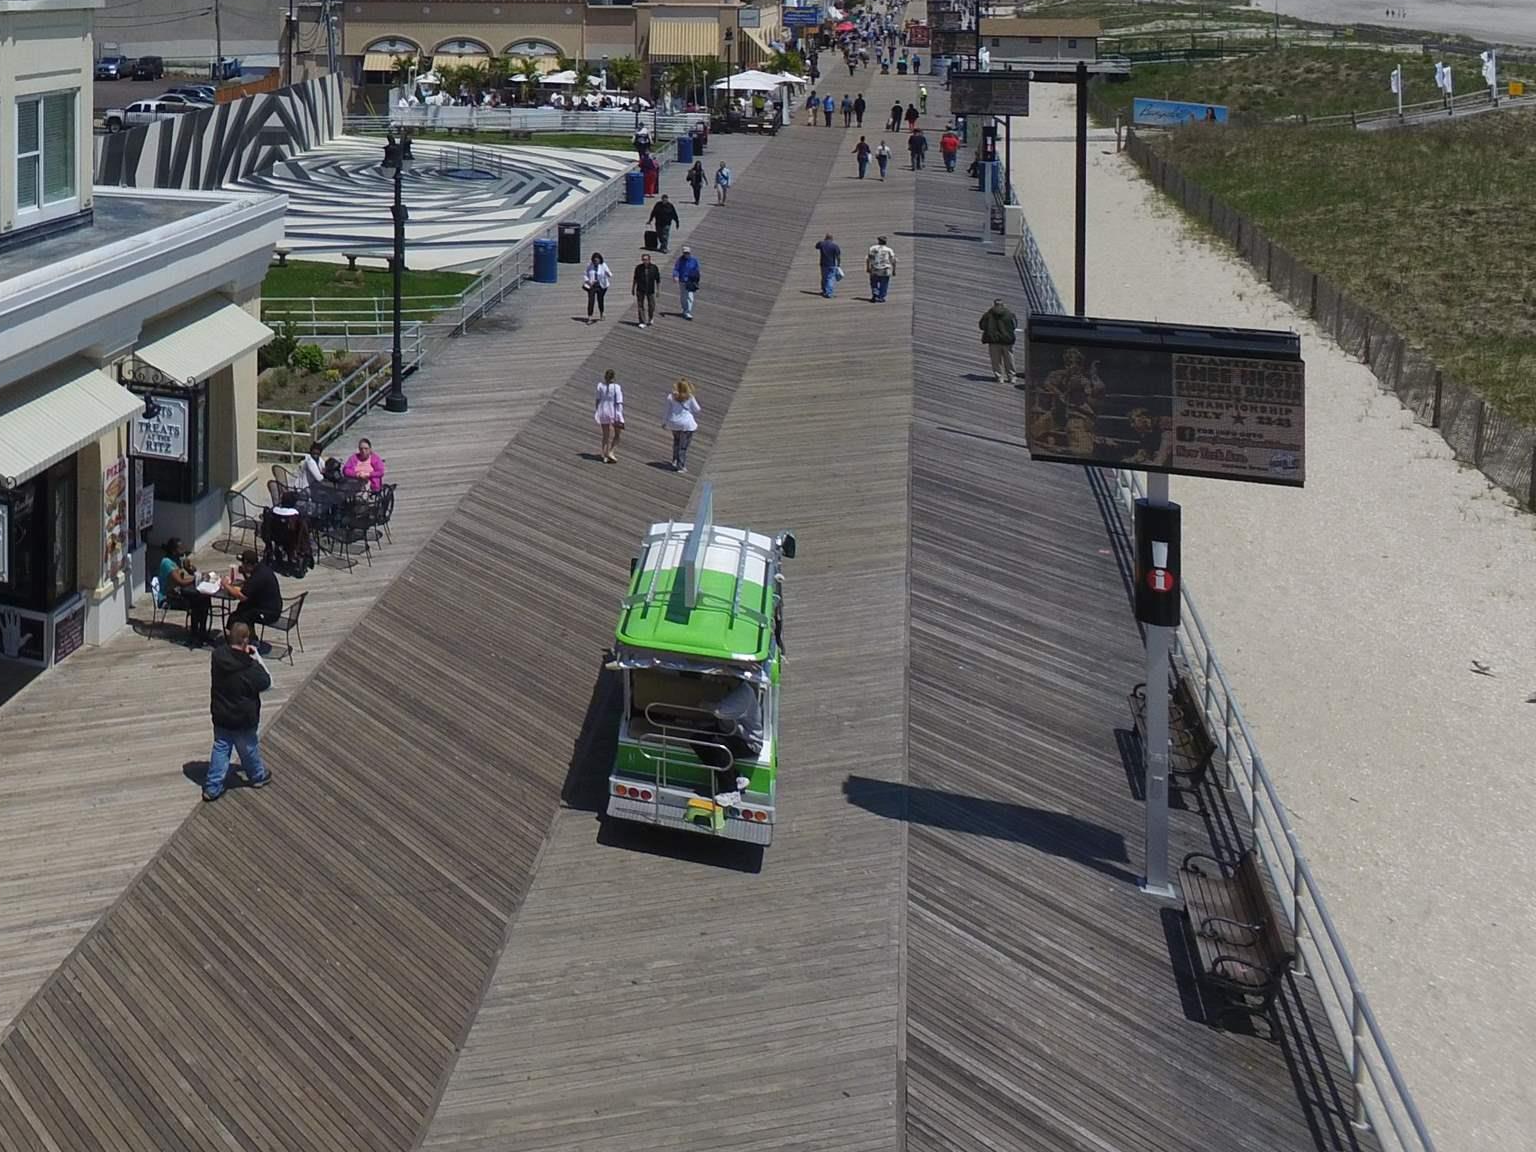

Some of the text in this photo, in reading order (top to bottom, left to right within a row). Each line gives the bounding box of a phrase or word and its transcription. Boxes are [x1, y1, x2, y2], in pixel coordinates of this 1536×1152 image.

[1176, 355, 1260, 369] ATLANTIC
[1180, 409, 1224, 420] JULY
[1186, 399, 1293, 416] CHAMPIONSHIP
[137, 421, 180, 438] TREATS
[157, 434, 172, 442] THE
[145, 440, 172, 454] RITZ
[106, 459, 127, 479] PIZZA
